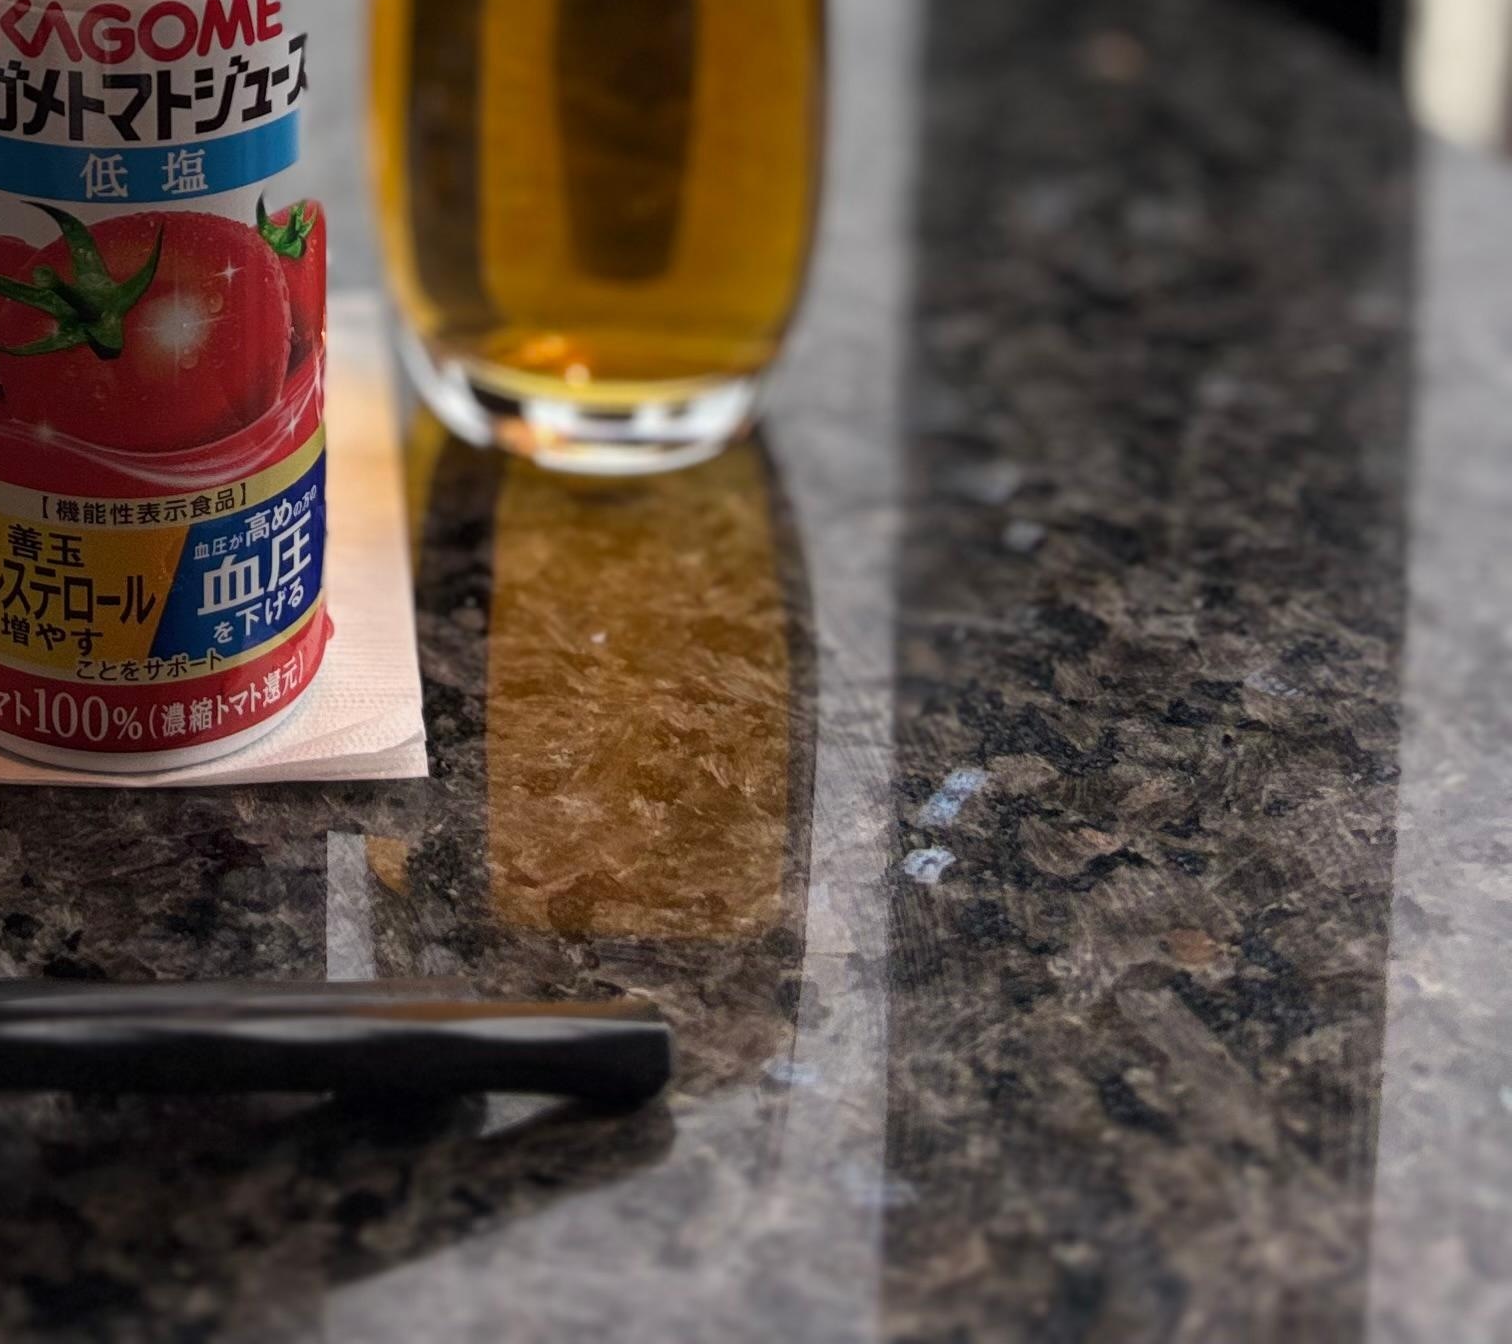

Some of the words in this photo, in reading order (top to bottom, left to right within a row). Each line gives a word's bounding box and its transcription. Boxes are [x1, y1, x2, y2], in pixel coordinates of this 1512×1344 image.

[7, 523, 85, 568] 善玉
[193, 484, 318, 560] 血圧が高めの方の
[197, 509, 312, 616] 血圧
[212, 576, 304, 644] を下げる
[76, 650, 223, 682] ことをサポート
